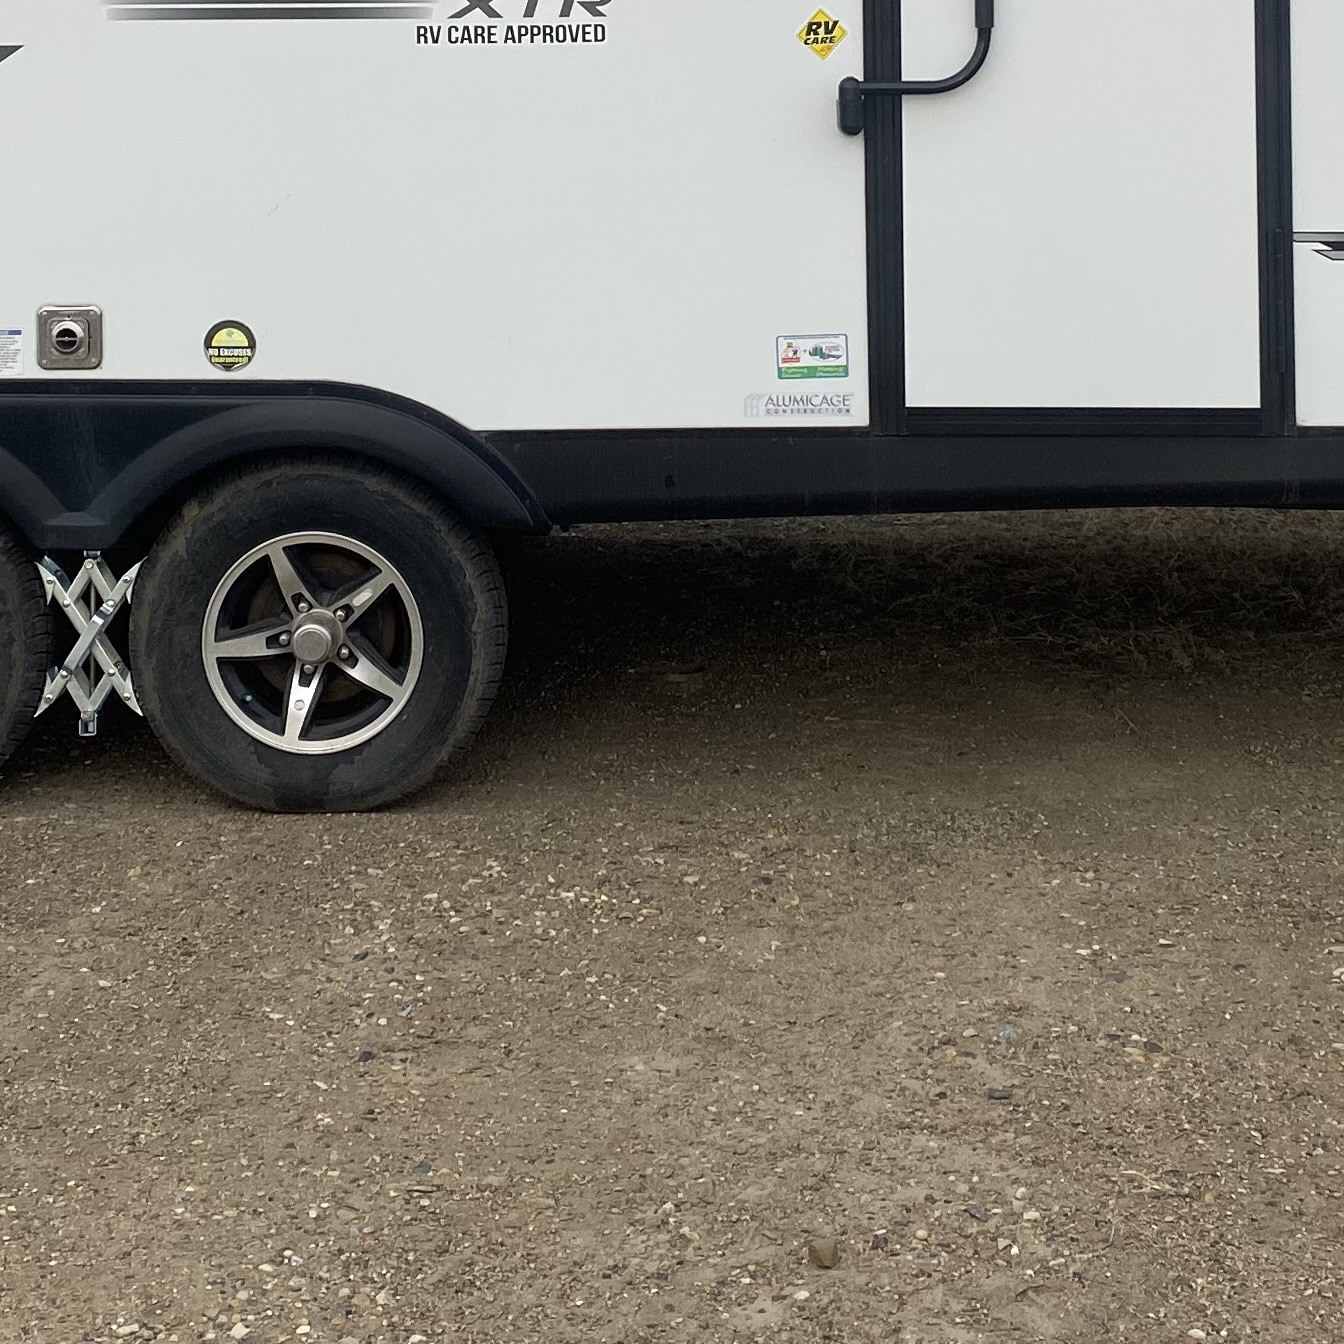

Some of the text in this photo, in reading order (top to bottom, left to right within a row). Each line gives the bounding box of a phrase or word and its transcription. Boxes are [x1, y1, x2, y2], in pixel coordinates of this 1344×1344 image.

[416, 23, 606, 45] RV CARE APPROVED
[805, 20, 840, 37] RV
[803, 35, 837, 46] CARE
[765, 395, 851, 407] ALUMICAGE
